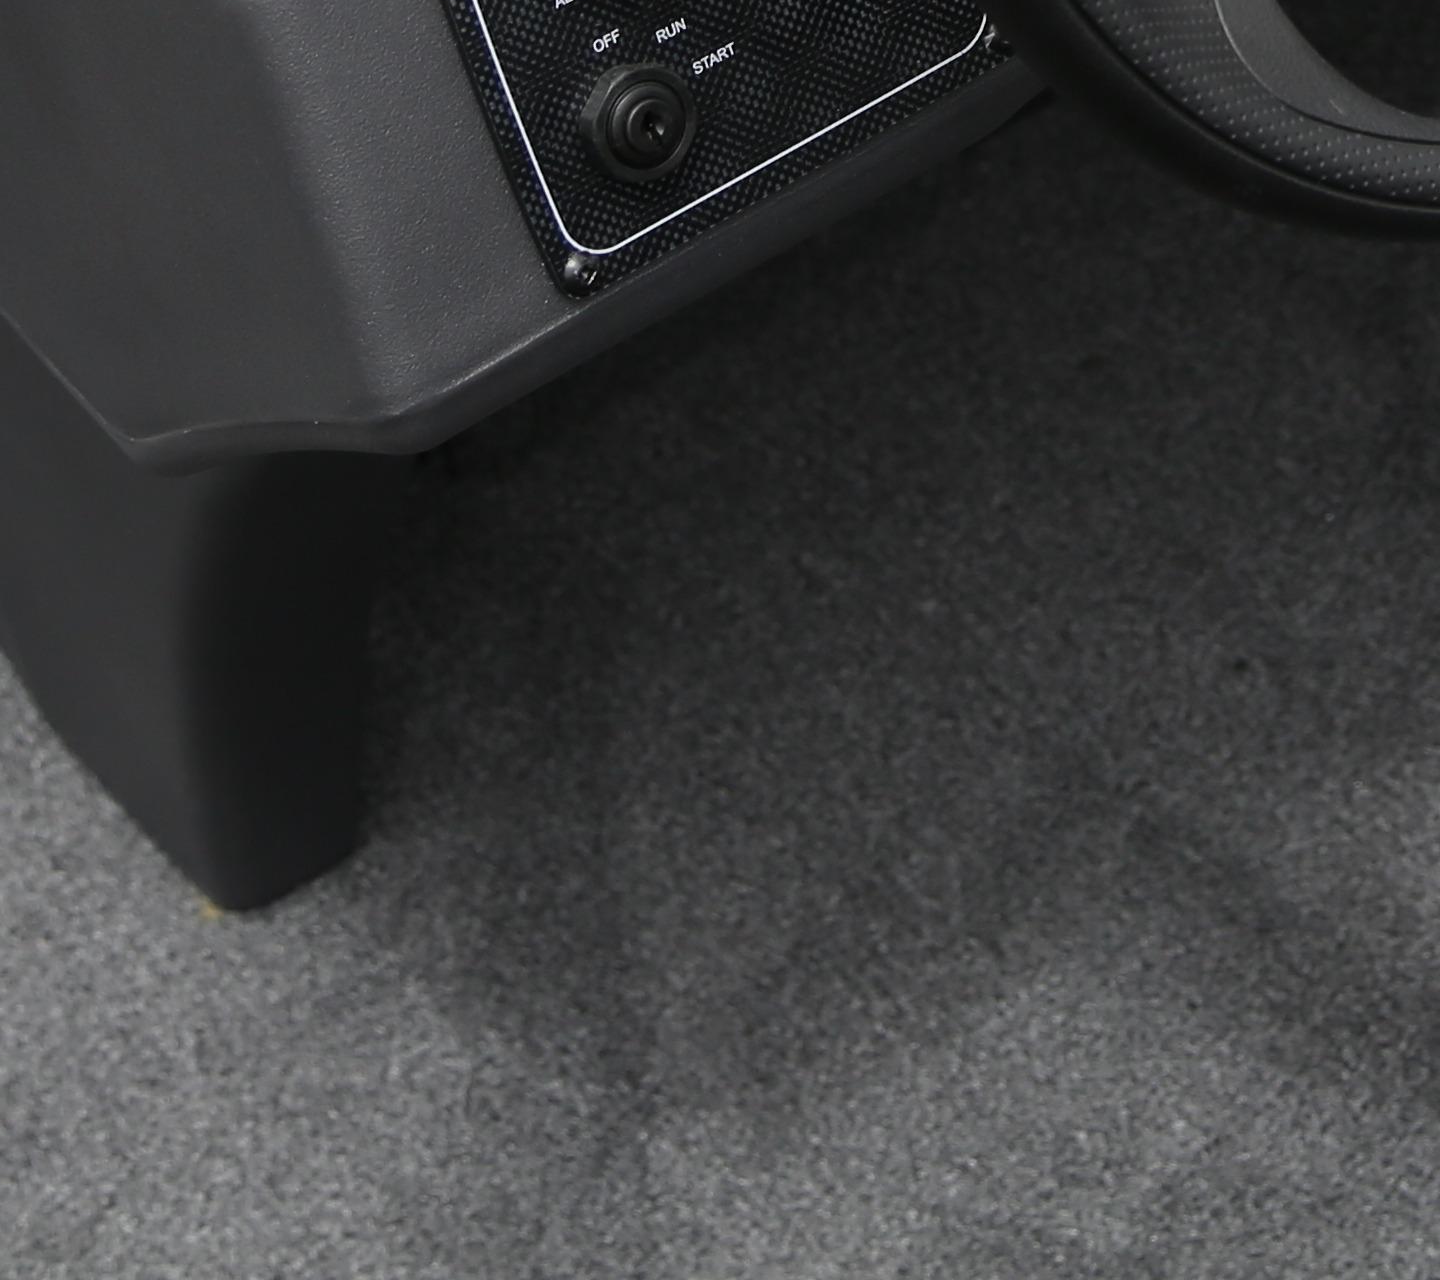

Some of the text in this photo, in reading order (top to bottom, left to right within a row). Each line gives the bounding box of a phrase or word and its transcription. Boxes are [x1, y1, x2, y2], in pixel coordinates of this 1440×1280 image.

[592, 28, 621, 53] OFF
[655, 17, 687, 43] RUN
[692, 41, 735, 75] START
